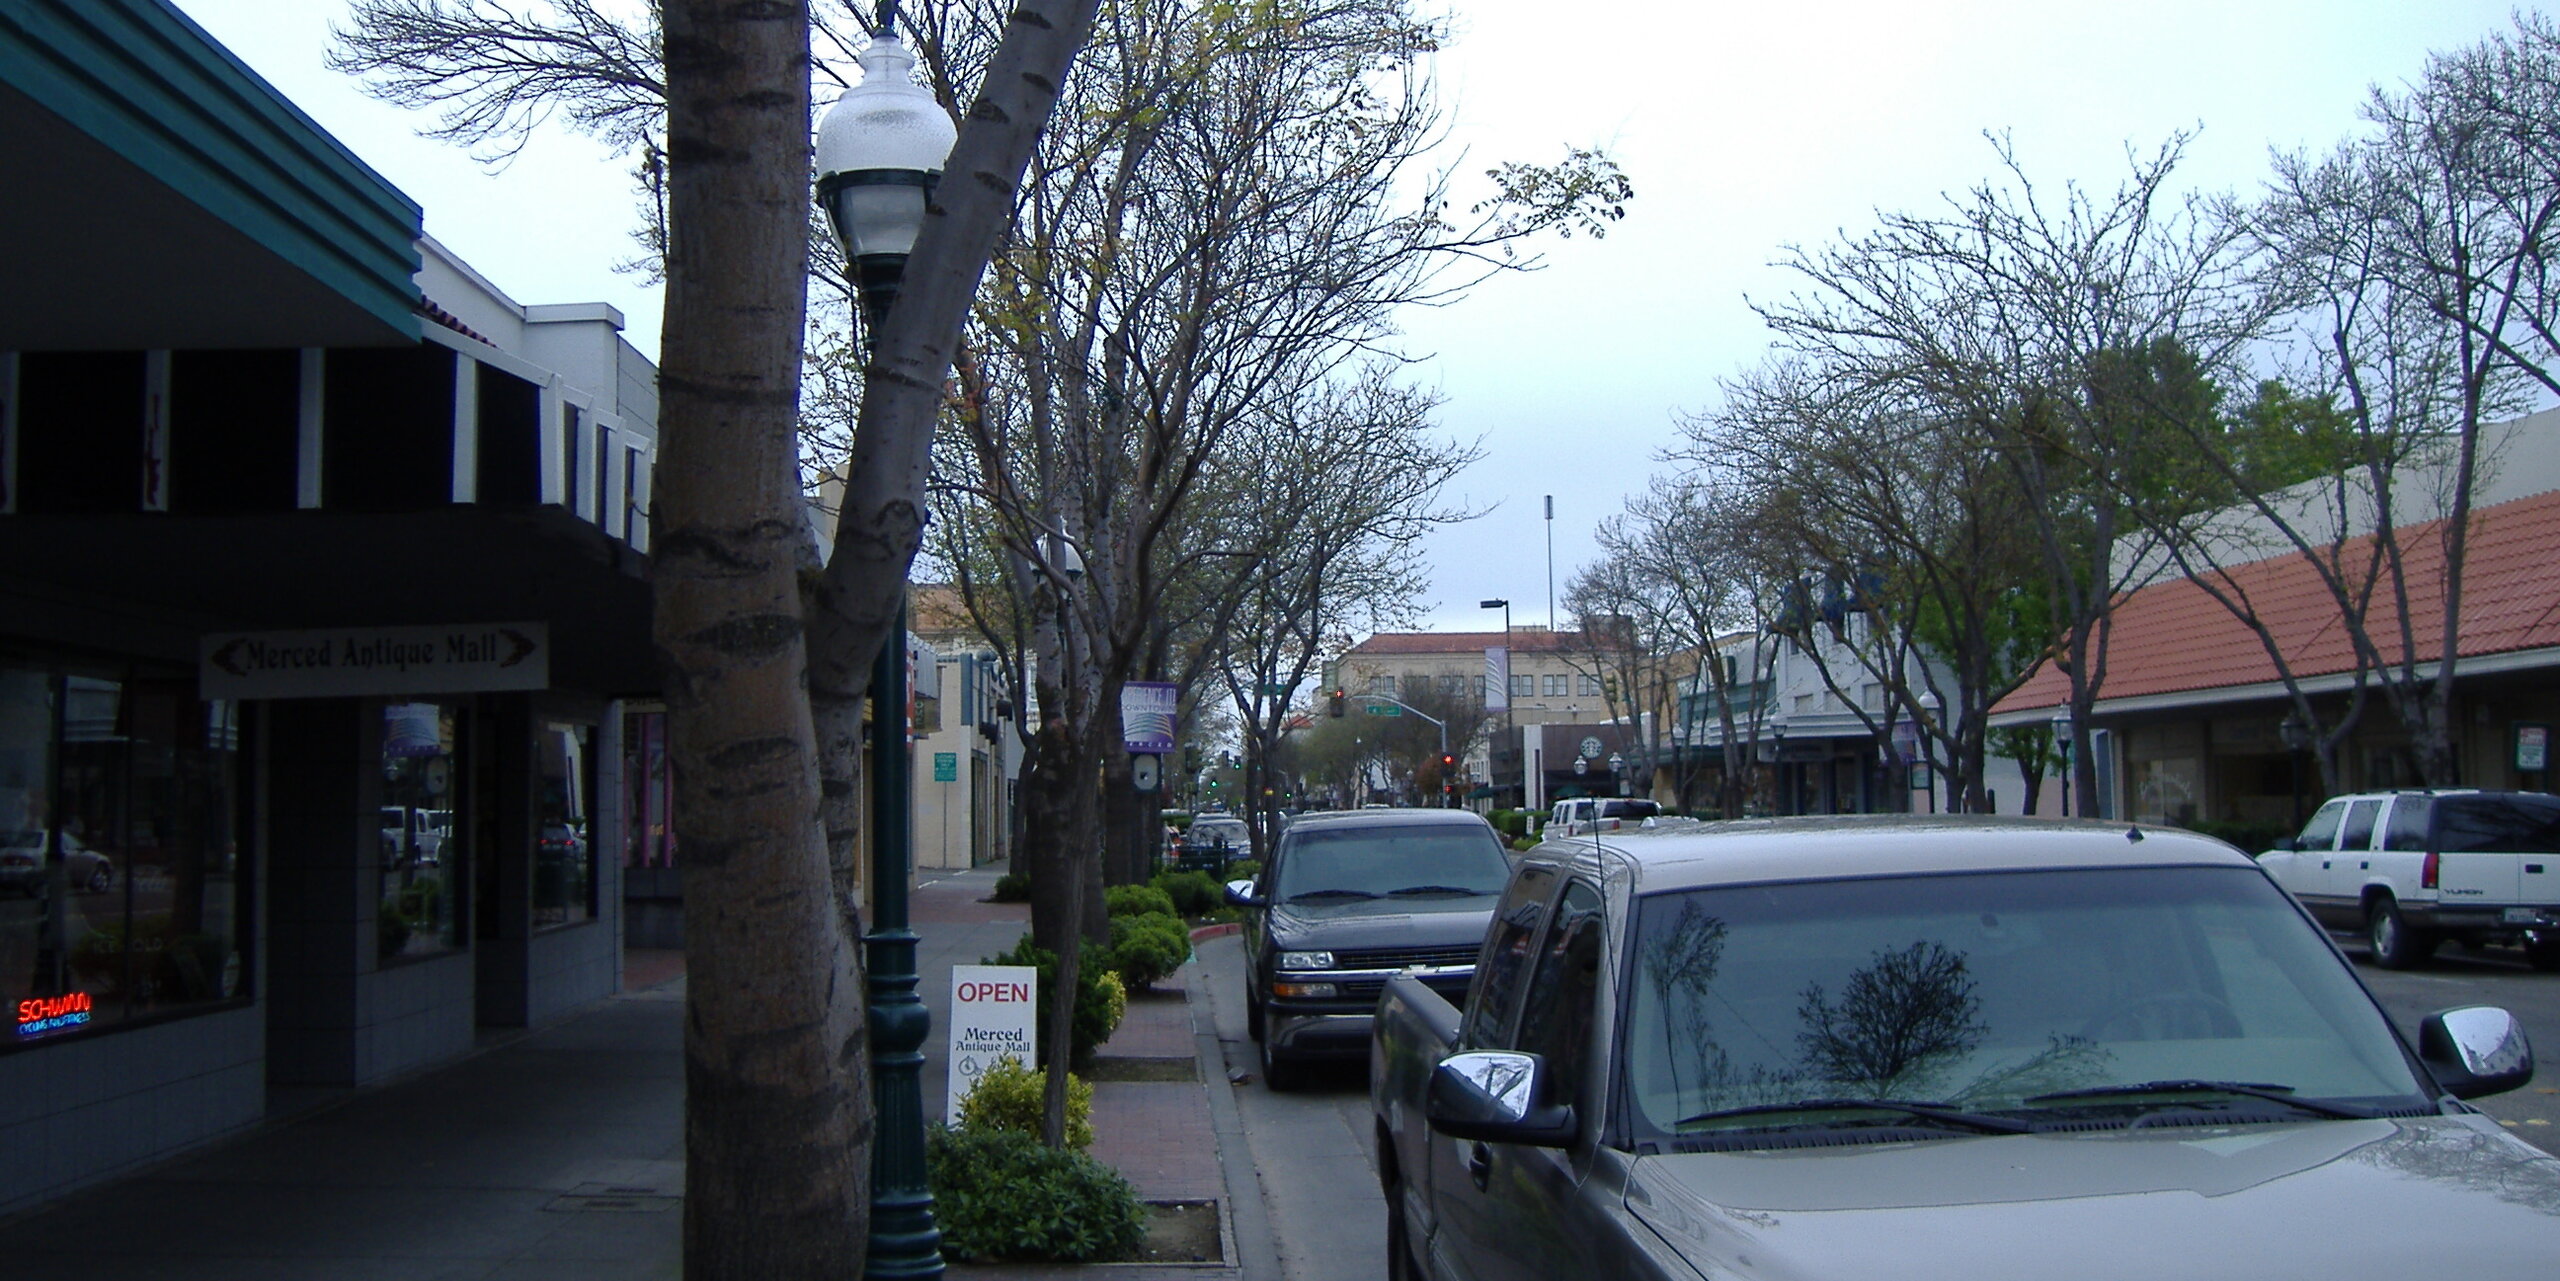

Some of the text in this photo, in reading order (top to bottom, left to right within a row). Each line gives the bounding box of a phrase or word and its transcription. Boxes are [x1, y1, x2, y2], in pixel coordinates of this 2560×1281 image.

[247, 633, 497, 672] Merced Antique Mall
[957, 982, 1029, 1002] OPEN
[17, 991, 92, 1021] SCHWINN
[964, 1027, 1023, 1041] Merced
[955, 1041, 1030, 1053] Antique Mall
